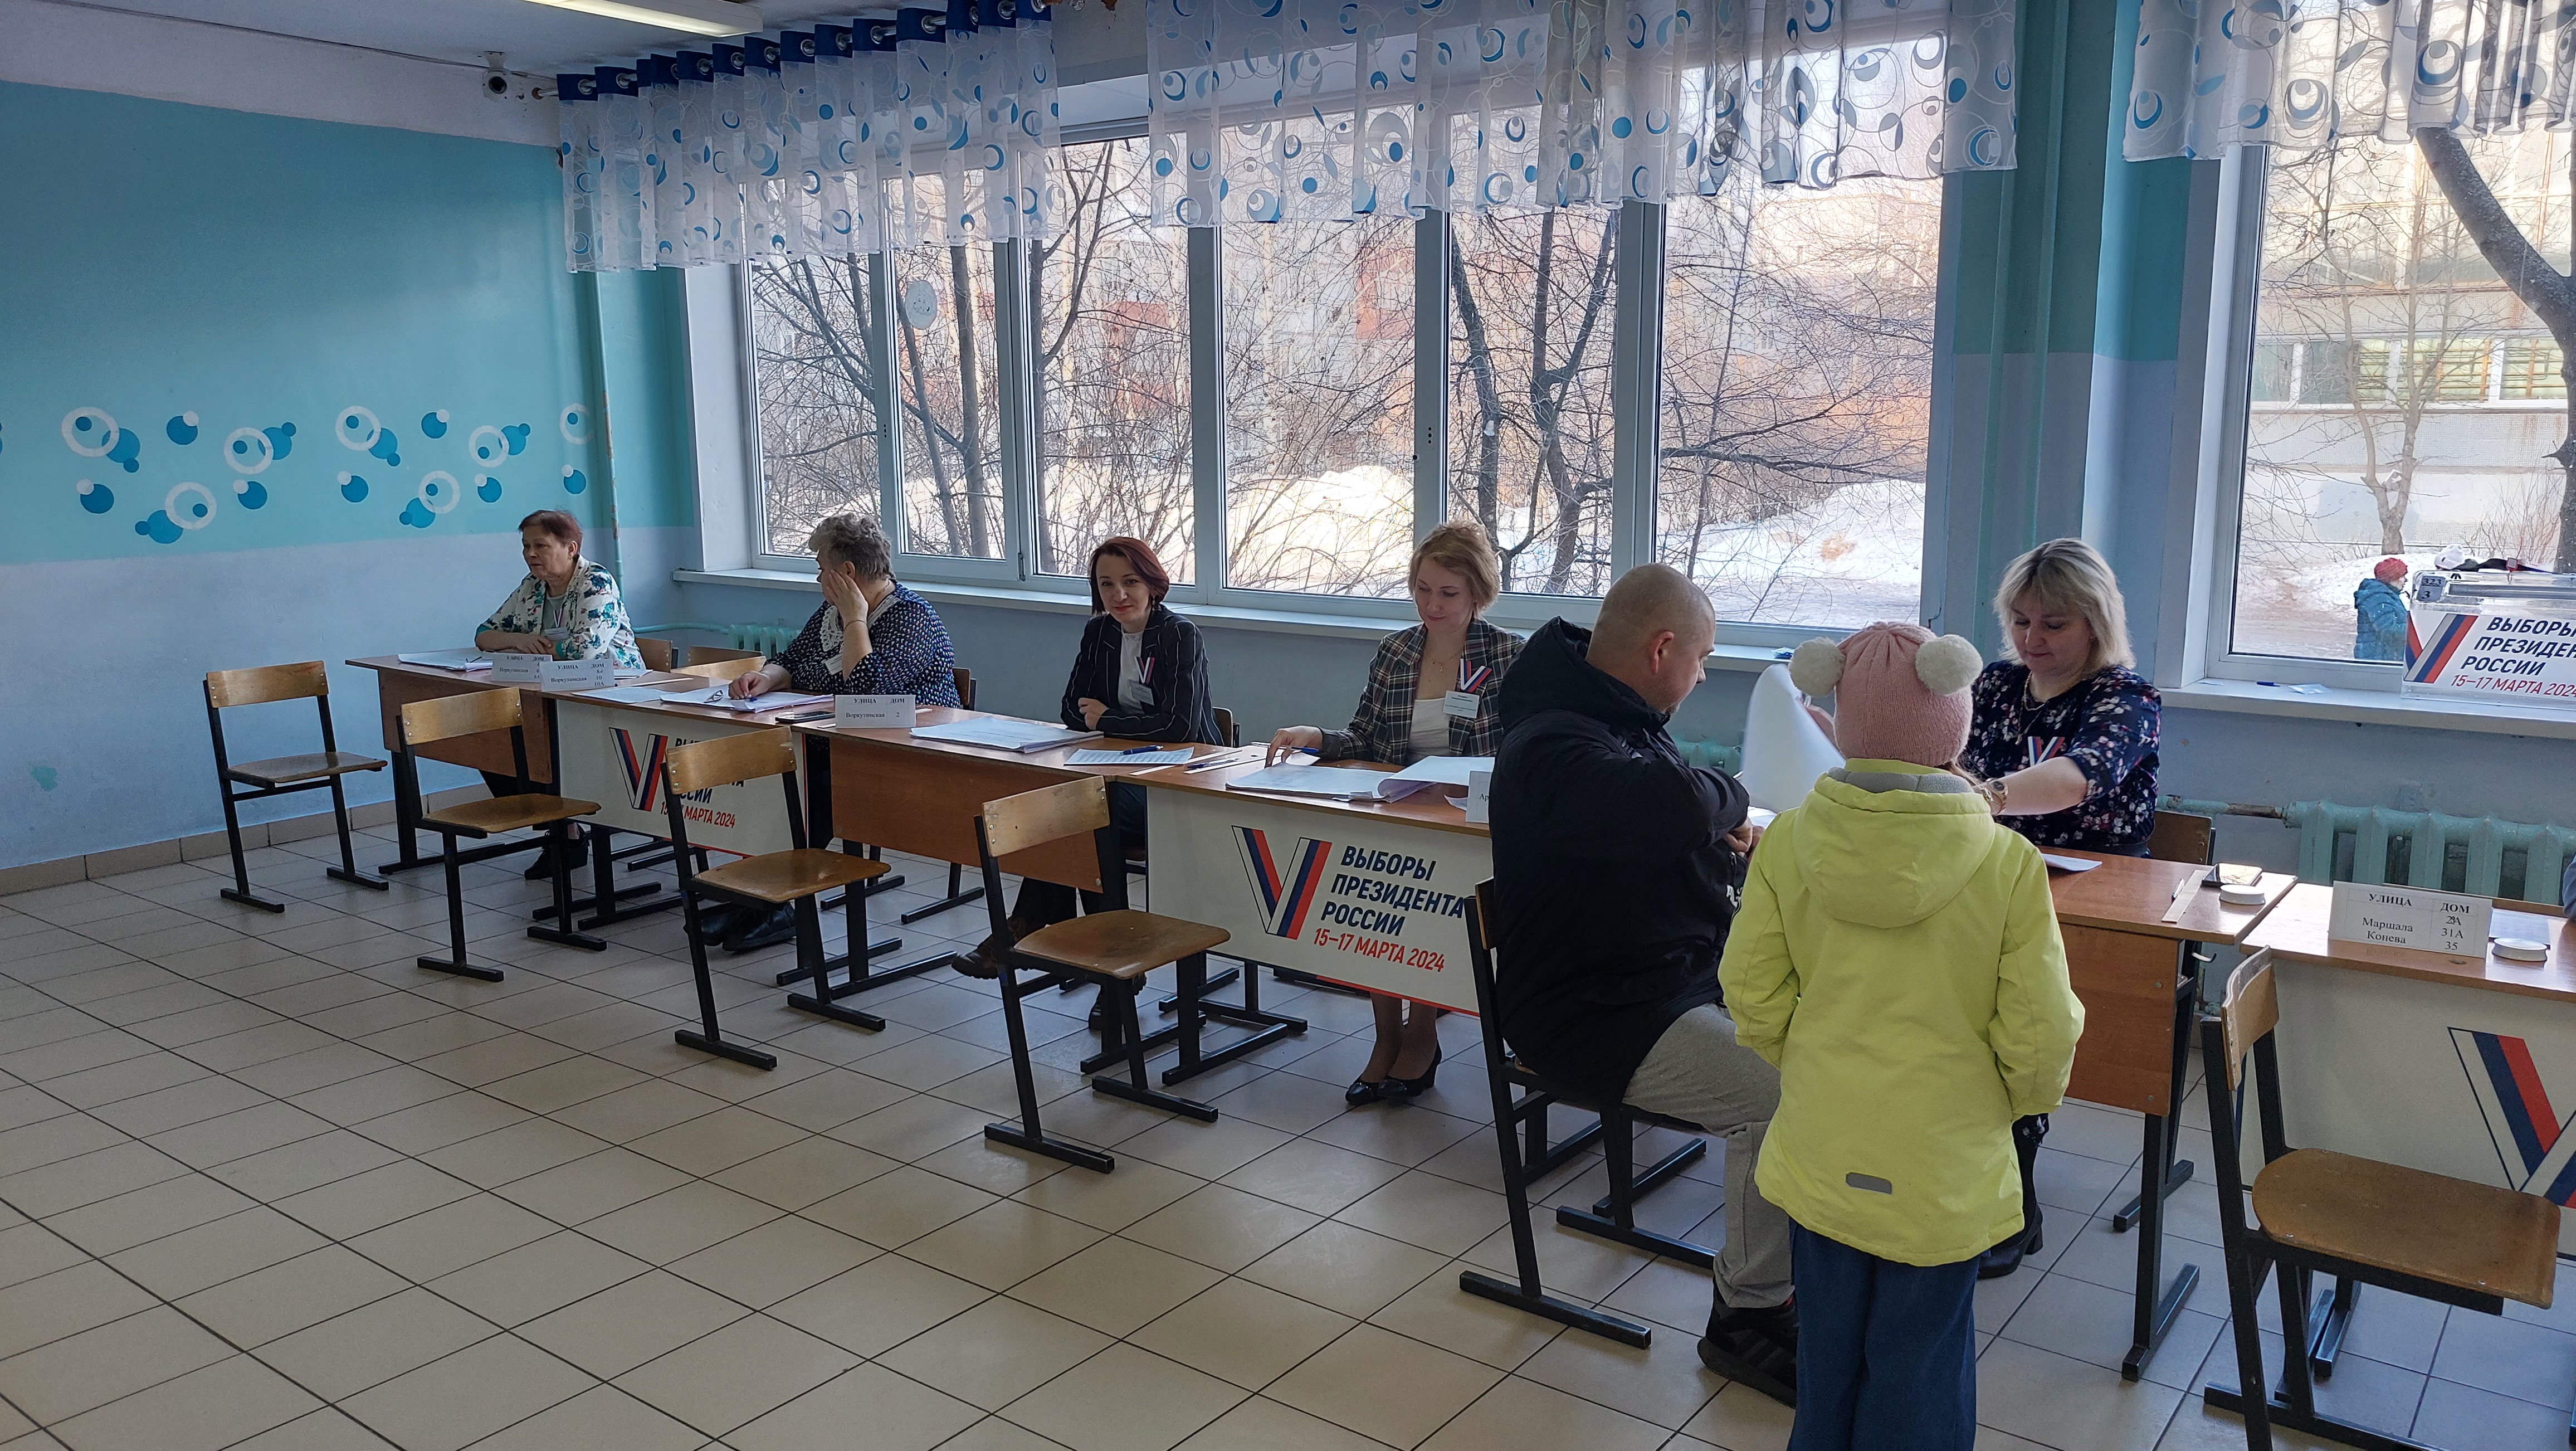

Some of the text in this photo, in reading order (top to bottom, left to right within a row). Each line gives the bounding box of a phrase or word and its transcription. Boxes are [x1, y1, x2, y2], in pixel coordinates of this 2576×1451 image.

[2486, 617, 2576, 637] ВЫБОРЫ
[2460, 656, 2546, 676] РОССИИ
[2491, 678, 2544, 694] МАРТА
[684, 806, 713, 824] МАРТА
[714, 811, 736, 829] 2024
[1340, 845, 1436, 881] ВЫБОРЫ
[1330, 873, 1465, 918] ПРЕЗИДЕНТА
[2368, 893, 2470, 914] УЛИЦА ДОМ
[1321, 901, 1406, 936] РОССИИ
[2362, 917, 2463, 939] Маршала 31А
[2367, 931, 2458, 951] Конева 35
[1354, 936, 1405, 963] МАРТА
[1406, 948, 1445, 972] 2024
